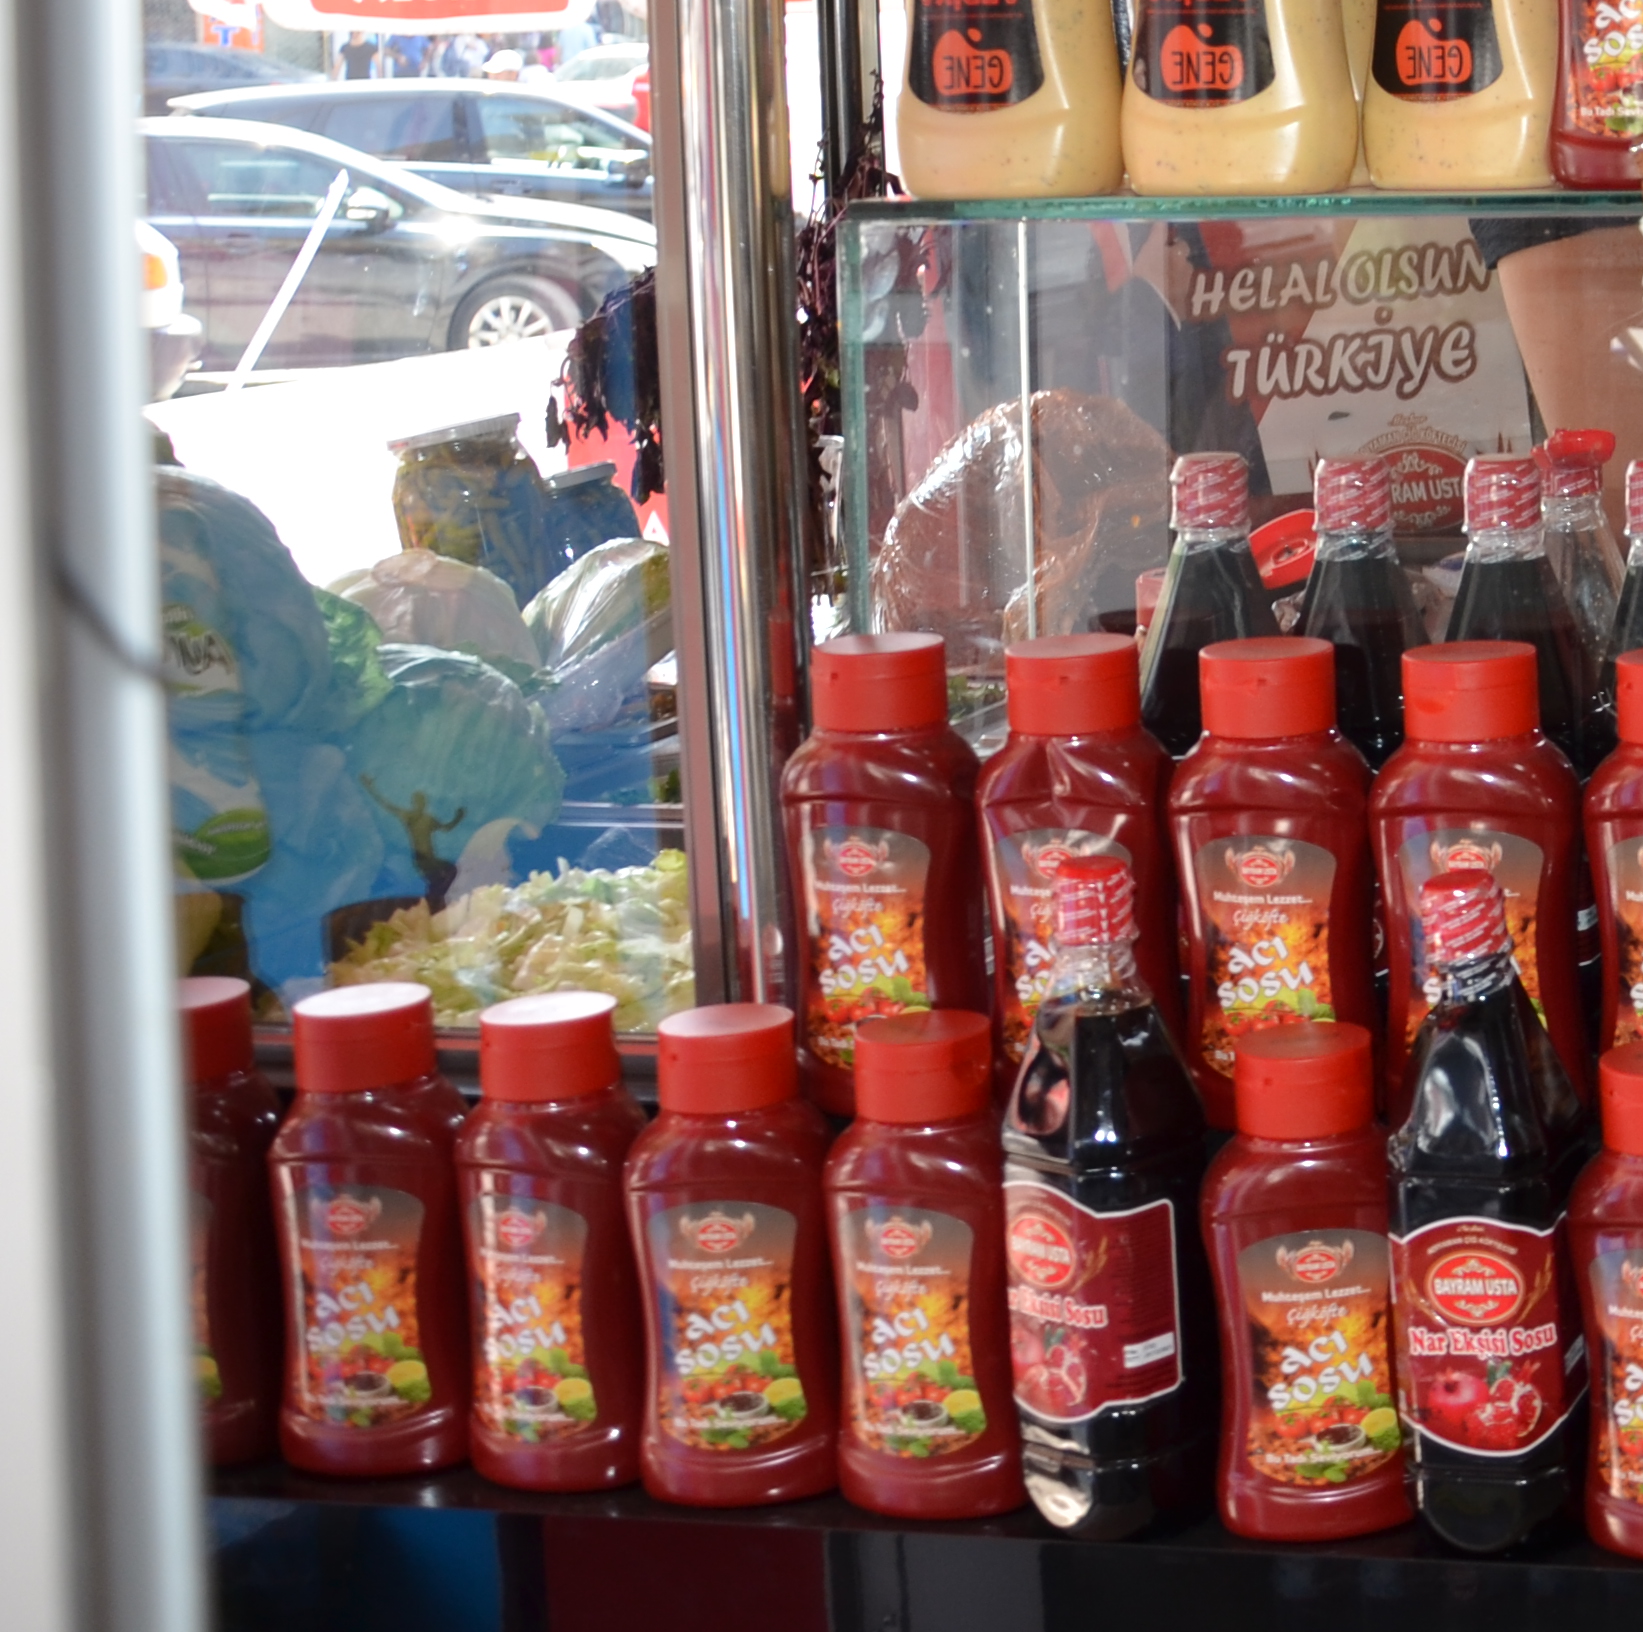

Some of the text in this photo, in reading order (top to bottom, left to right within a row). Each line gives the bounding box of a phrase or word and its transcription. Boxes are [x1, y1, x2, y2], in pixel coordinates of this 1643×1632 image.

[942, 55, 1004, 88] GENE
[1172, 51, 1235, 84] GENE
[1406, 45, 1463, 79] GENE
[1191, 243, 1490, 316] HELAL OLSUN
[1226, 306, 1474, 399] TÜRKİYE
[1391, 479, 1426, 504] RAM
[1434, 1278, 1518, 1295] BAYRAM USTA
[1063, 1296, 1109, 1329] Sosu
[1408, 1323, 1557, 1359] Nar Ekşisi Sosu
